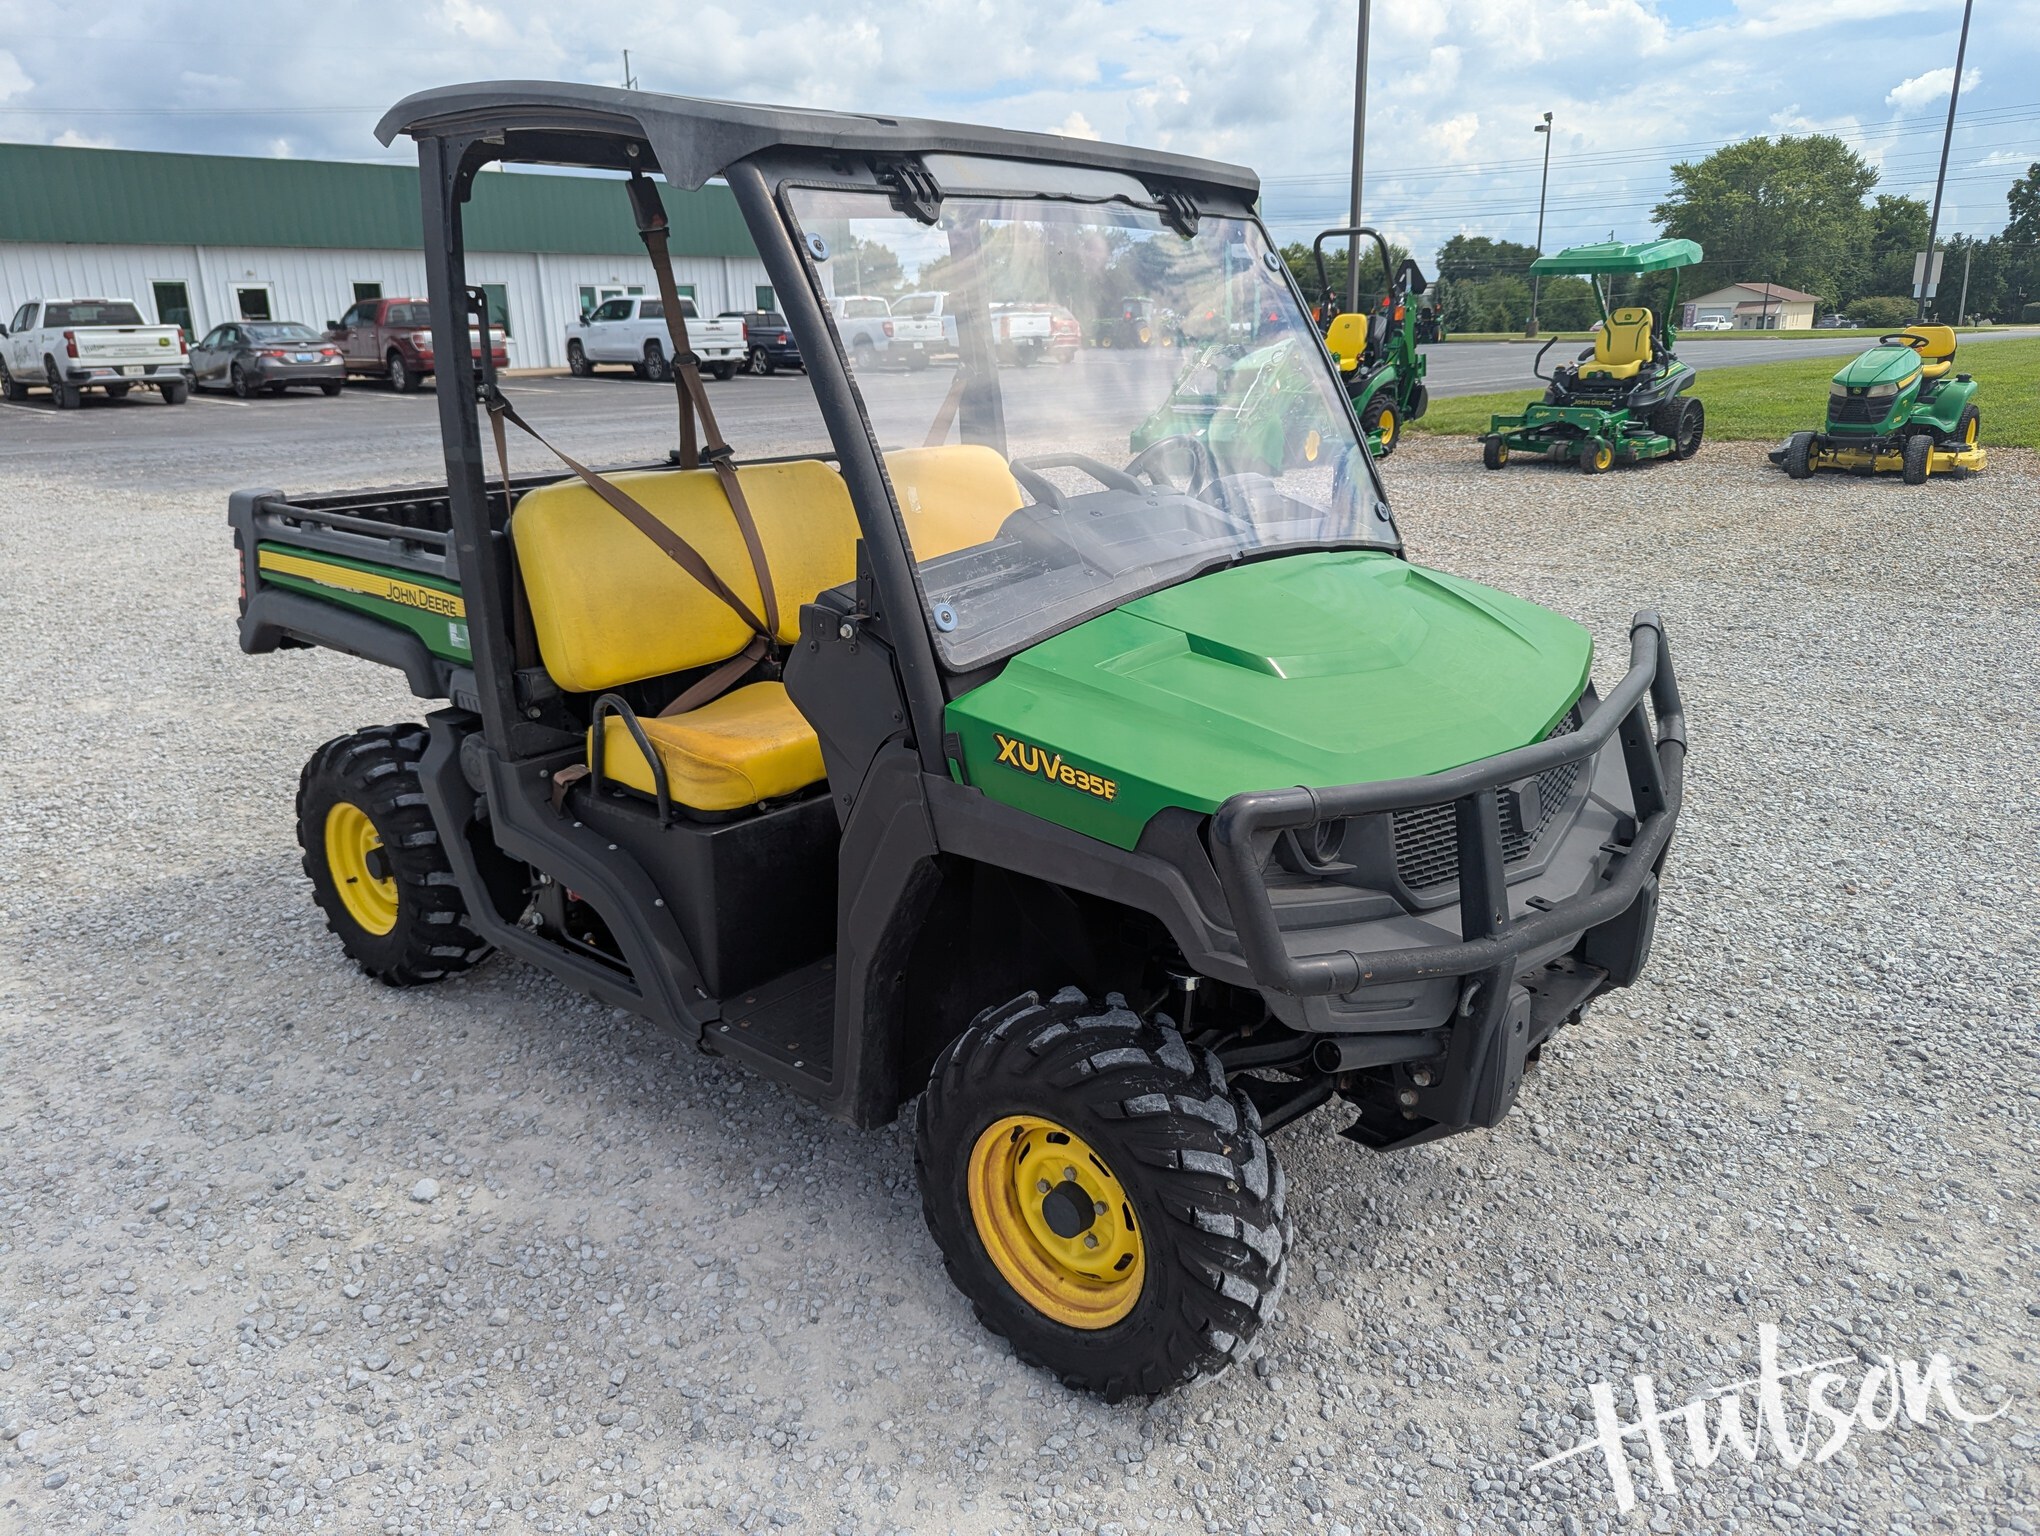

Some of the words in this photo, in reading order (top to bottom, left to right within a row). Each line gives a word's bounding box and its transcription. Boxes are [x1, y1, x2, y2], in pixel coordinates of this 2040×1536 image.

[386, 582, 417, 605] JOHN
[419, 589, 457, 615] DEERE
[994, 733, 1117, 800] XUV835E
